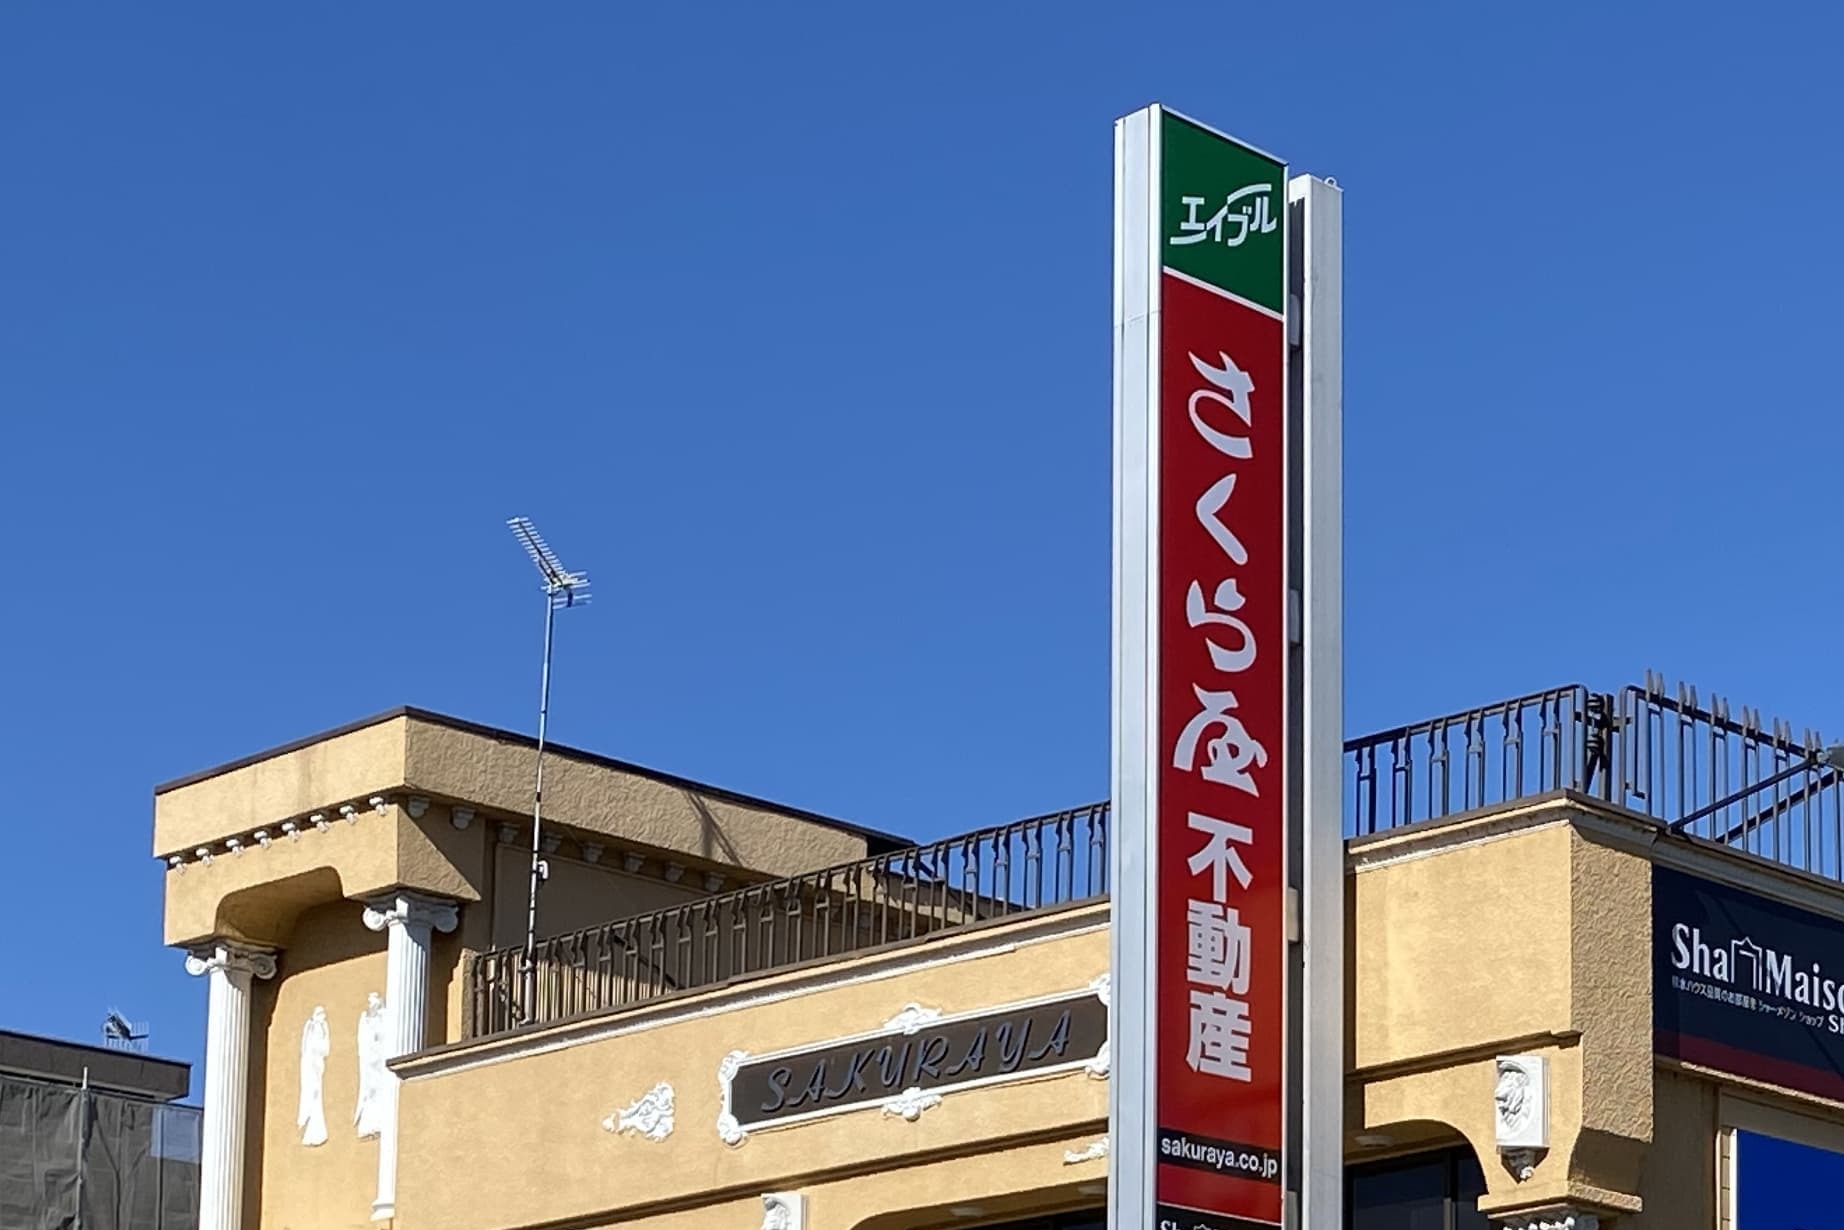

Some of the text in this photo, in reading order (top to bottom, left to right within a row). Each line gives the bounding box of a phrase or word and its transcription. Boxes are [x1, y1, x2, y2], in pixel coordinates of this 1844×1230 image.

[1170, 184, 1277, 247] エイブル
[1671, 922, 1729, 983] Sha
[761, 1010, 1071, 1112] SAKURAYA
[1161, 1137, 1278, 1178] sakuraya.co.jp
